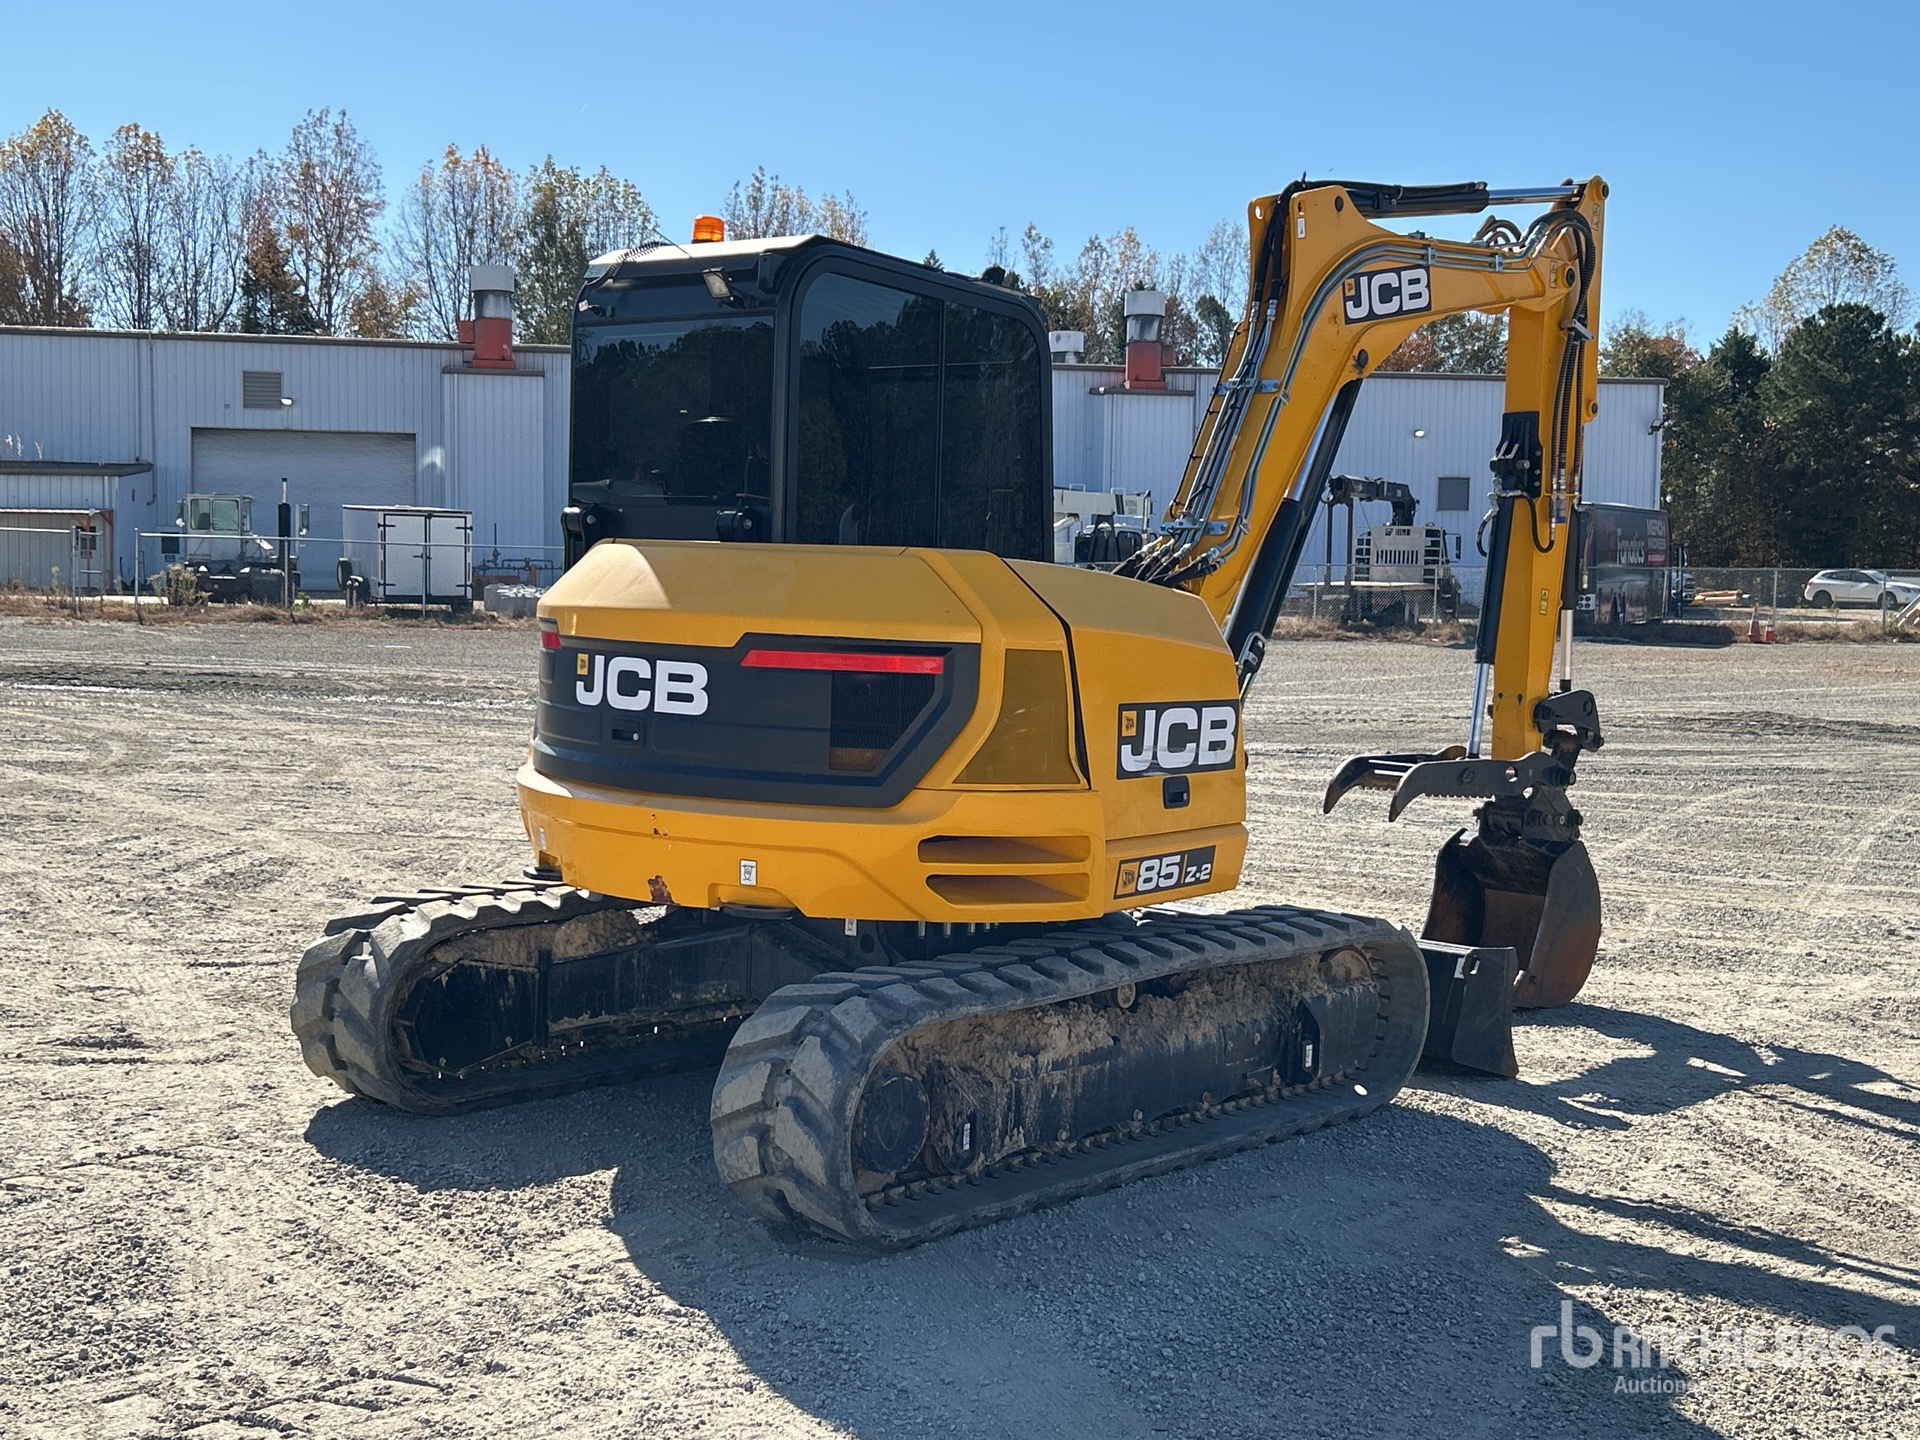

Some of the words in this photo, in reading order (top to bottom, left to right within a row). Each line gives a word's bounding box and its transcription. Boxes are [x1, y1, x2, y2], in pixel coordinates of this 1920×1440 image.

[1345, 269, 1429, 319] JCB
[575, 655, 708, 716] JCB
[1121, 706, 1236, 772] JCB
[1137, 855, 1181, 891] 85
